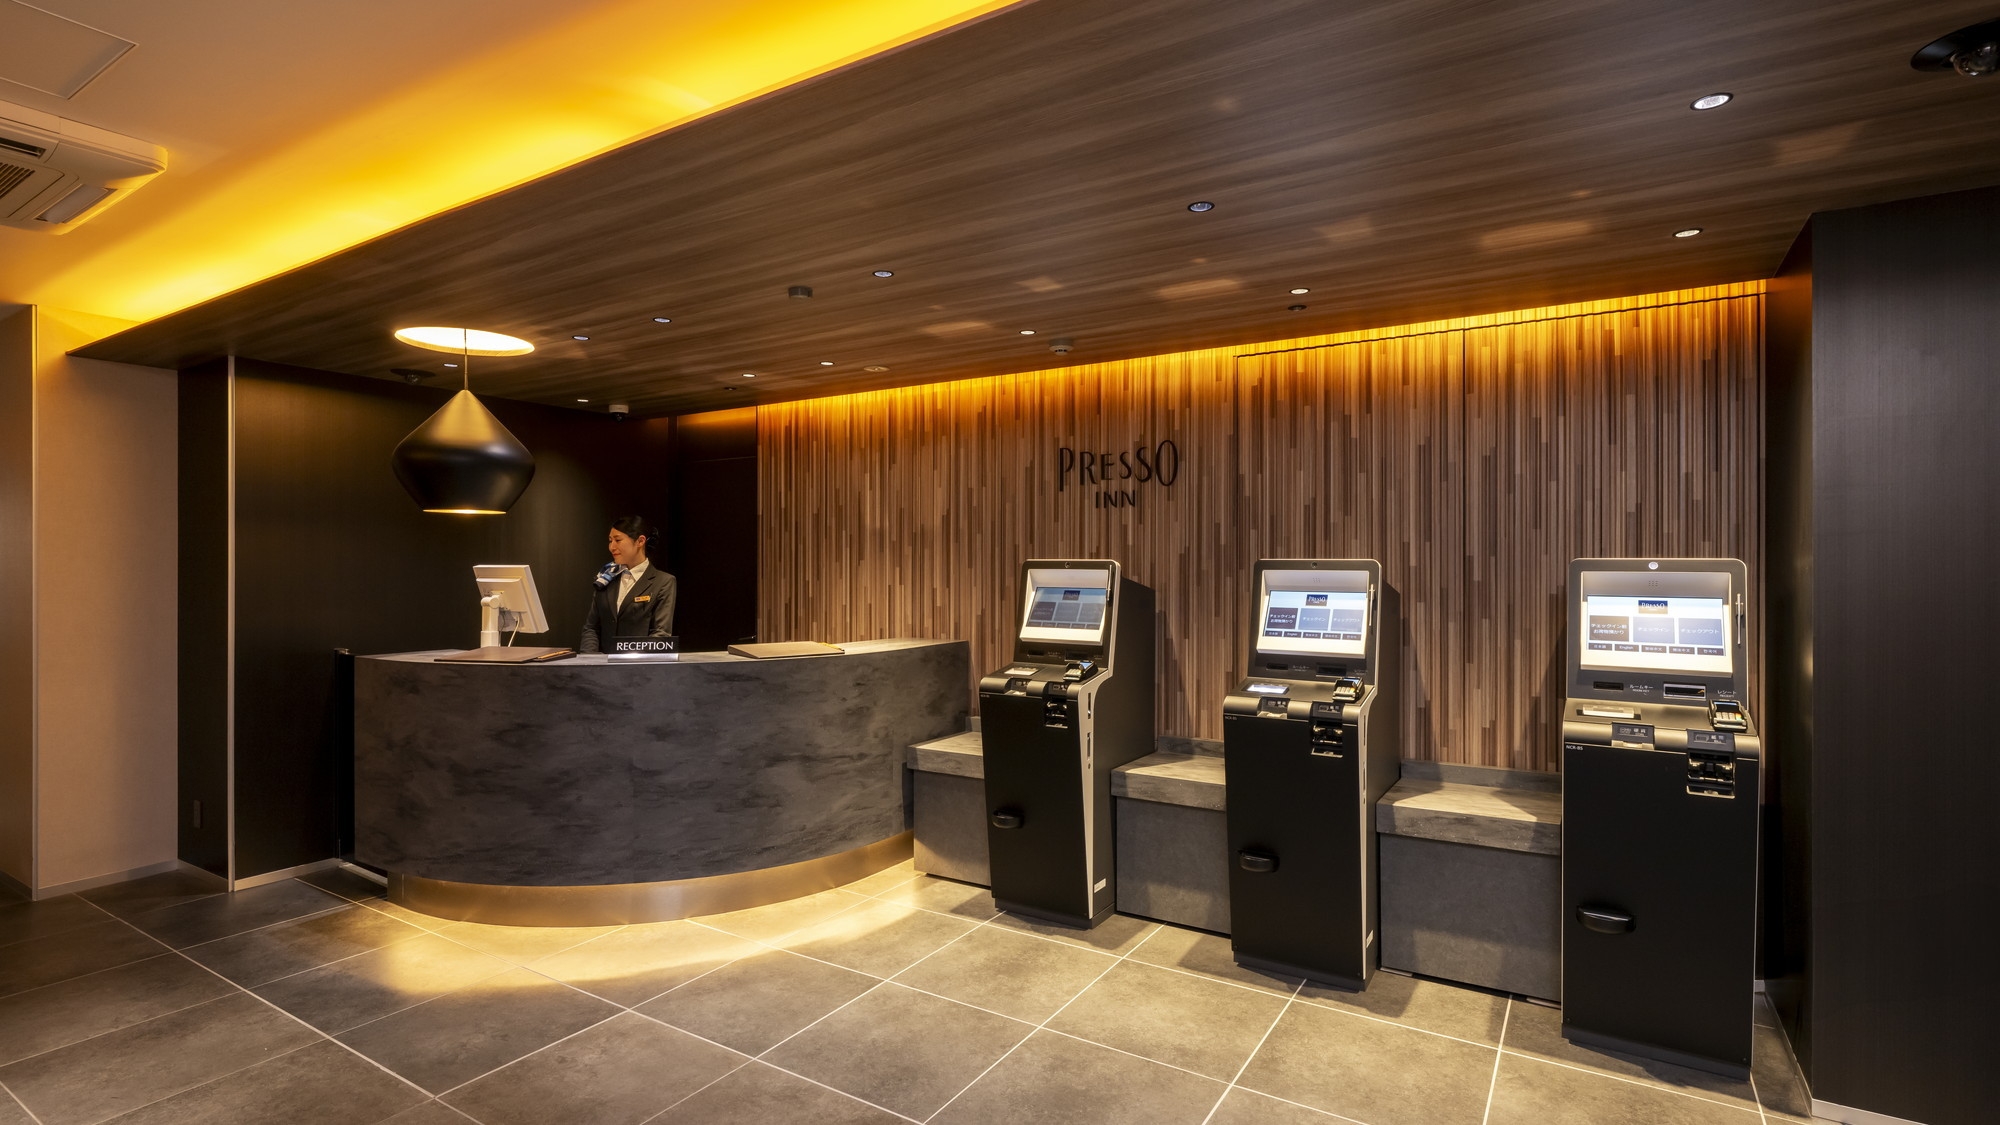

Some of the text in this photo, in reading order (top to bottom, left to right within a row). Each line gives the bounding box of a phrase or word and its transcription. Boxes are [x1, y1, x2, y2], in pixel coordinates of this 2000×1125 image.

[1059, 440, 1179, 492] PRESSO
[1095, 490, 1136, 509] INN
[616, 641, 674, 651] RECEPTION
